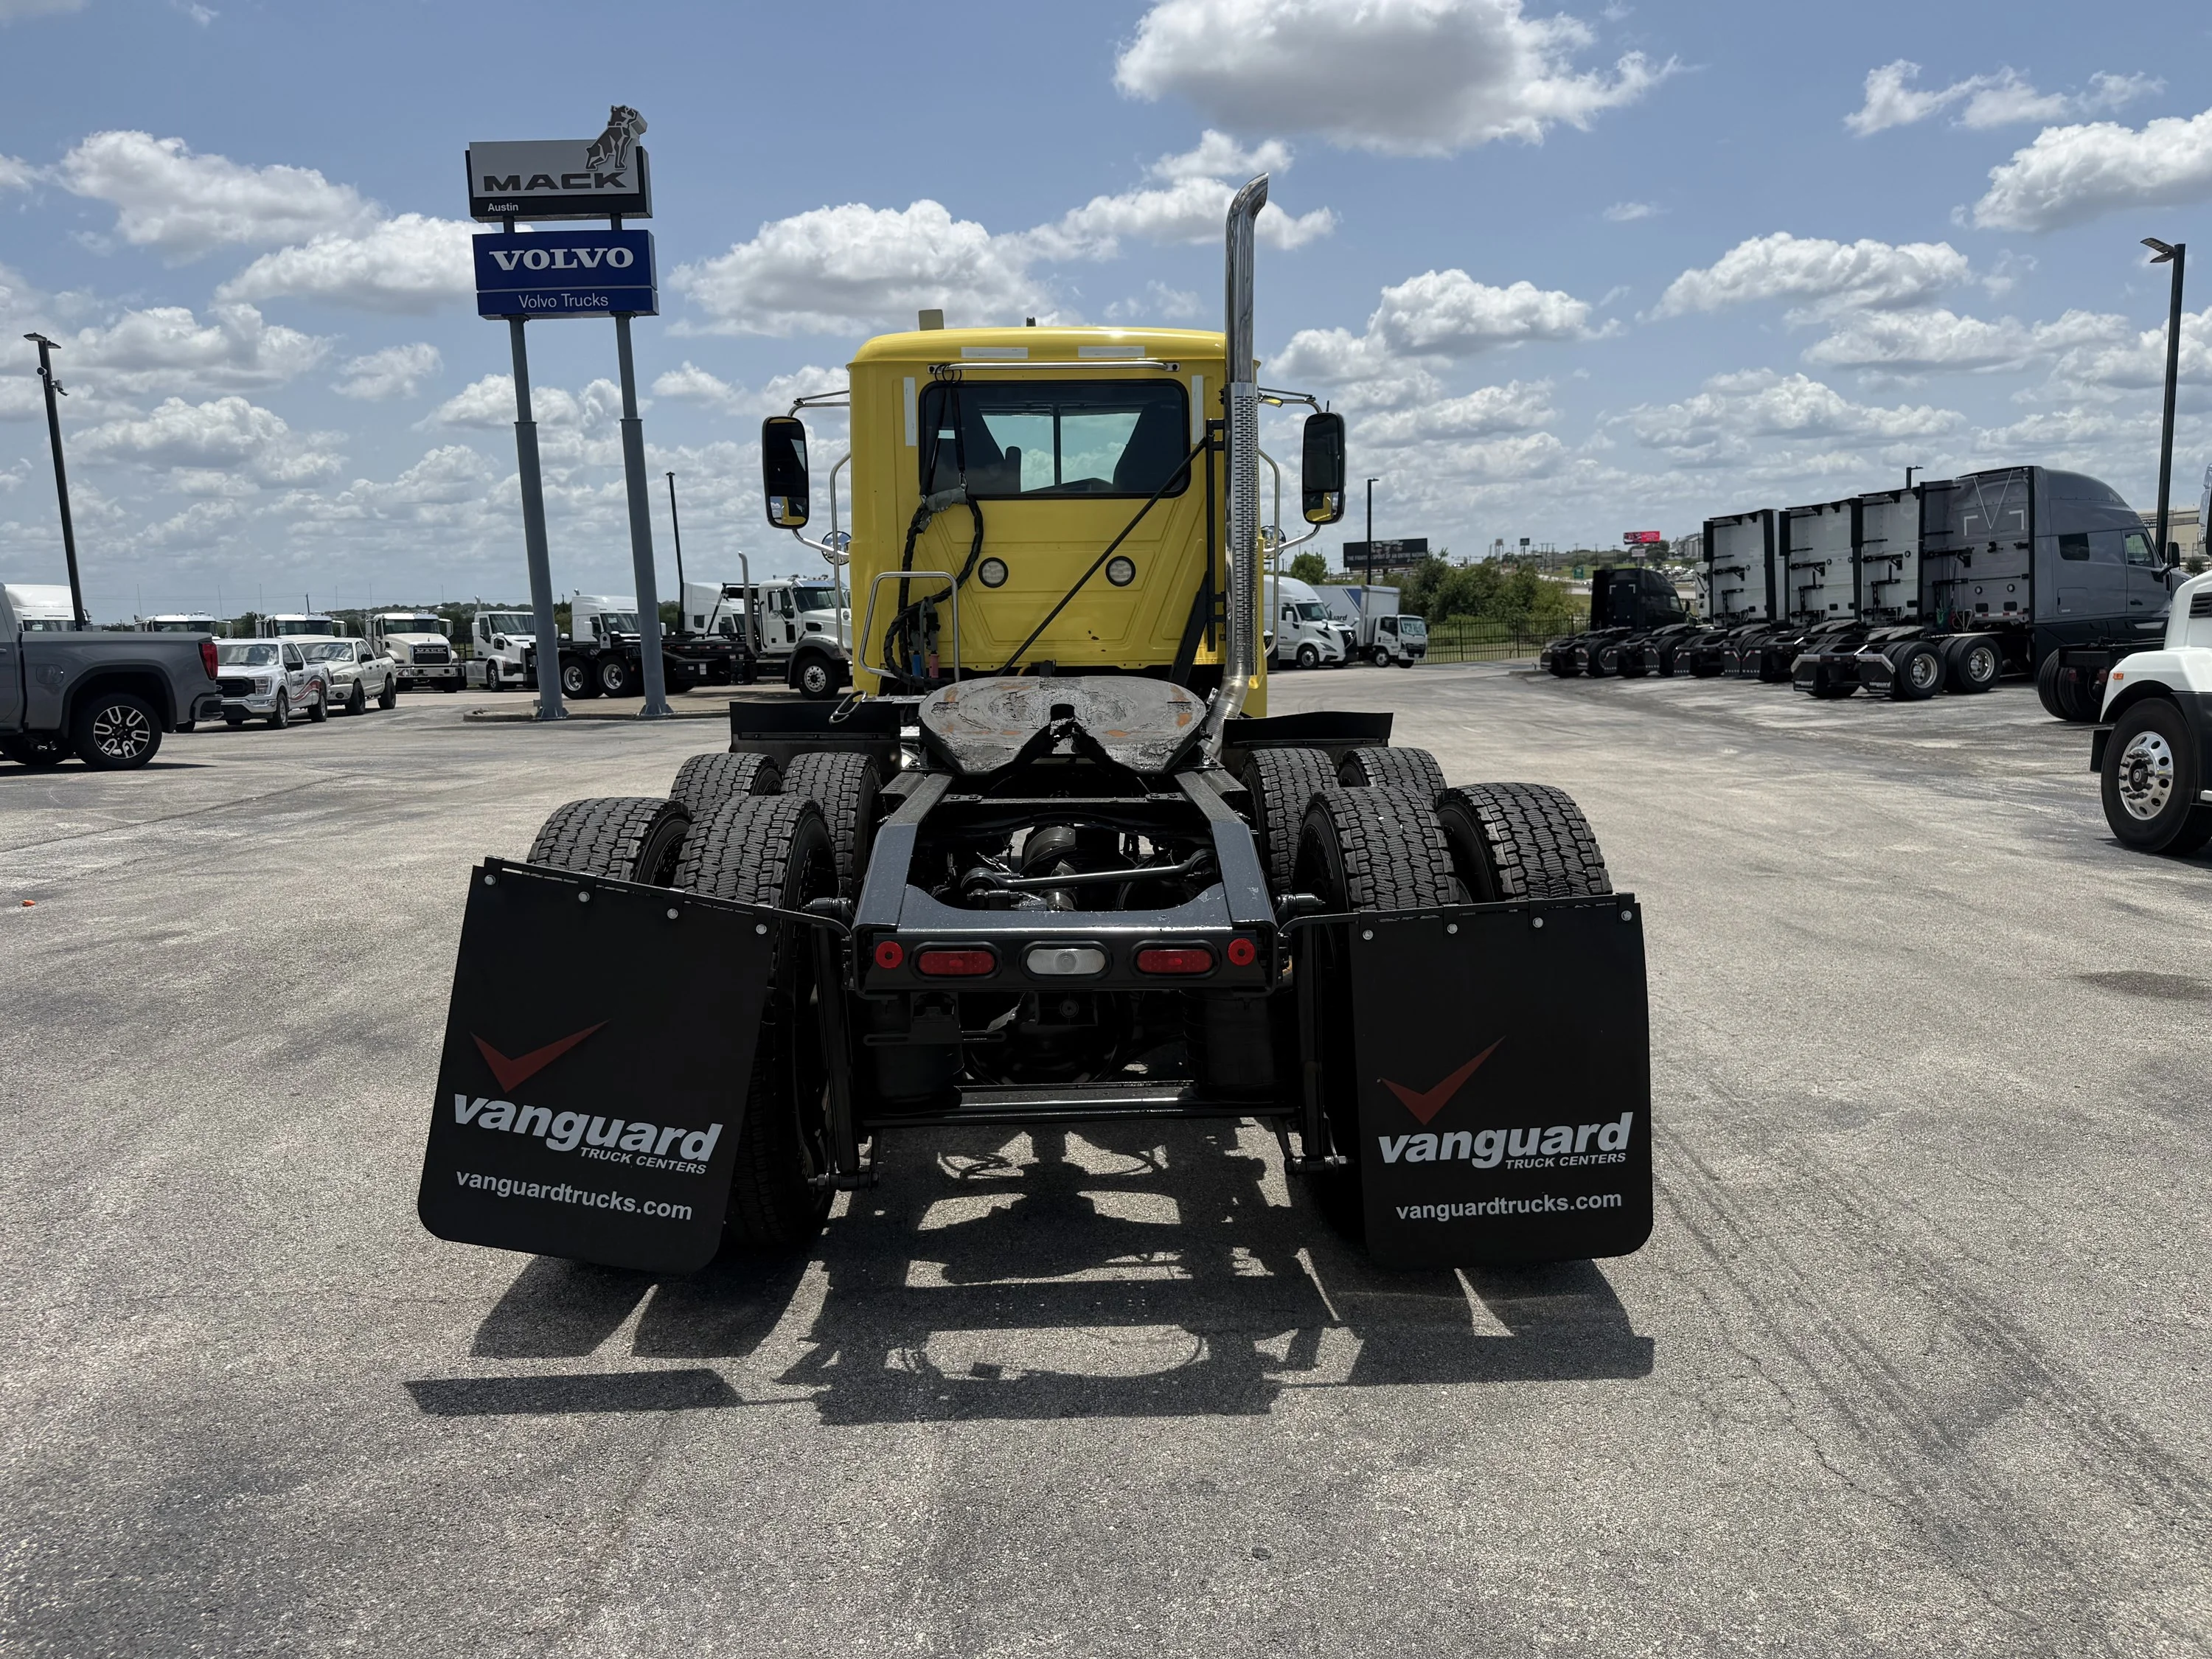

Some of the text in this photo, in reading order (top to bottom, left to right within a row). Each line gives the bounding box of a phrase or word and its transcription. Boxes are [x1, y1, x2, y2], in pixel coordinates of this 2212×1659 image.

[483, 172, 627, 191] MACK
[487, 203, 519, 212] Austin
[489, 247, 634, 271] VOLVO
[518, 293, 608, 308] Volvo Trucks
[454, 1093, 723, 1162] vanguard
[1378, 1111, 1634, 1169] vanguard
[580, 1147, 707, 1175] TRUCK CENTERS
[1505, 1152, 1627, 1169] TRUCK CENTERS
[456, 1171, 692, 1220] vanguardtrucks.com
[1396, 1193, 1622, 1222] vanguardtrucks.com
